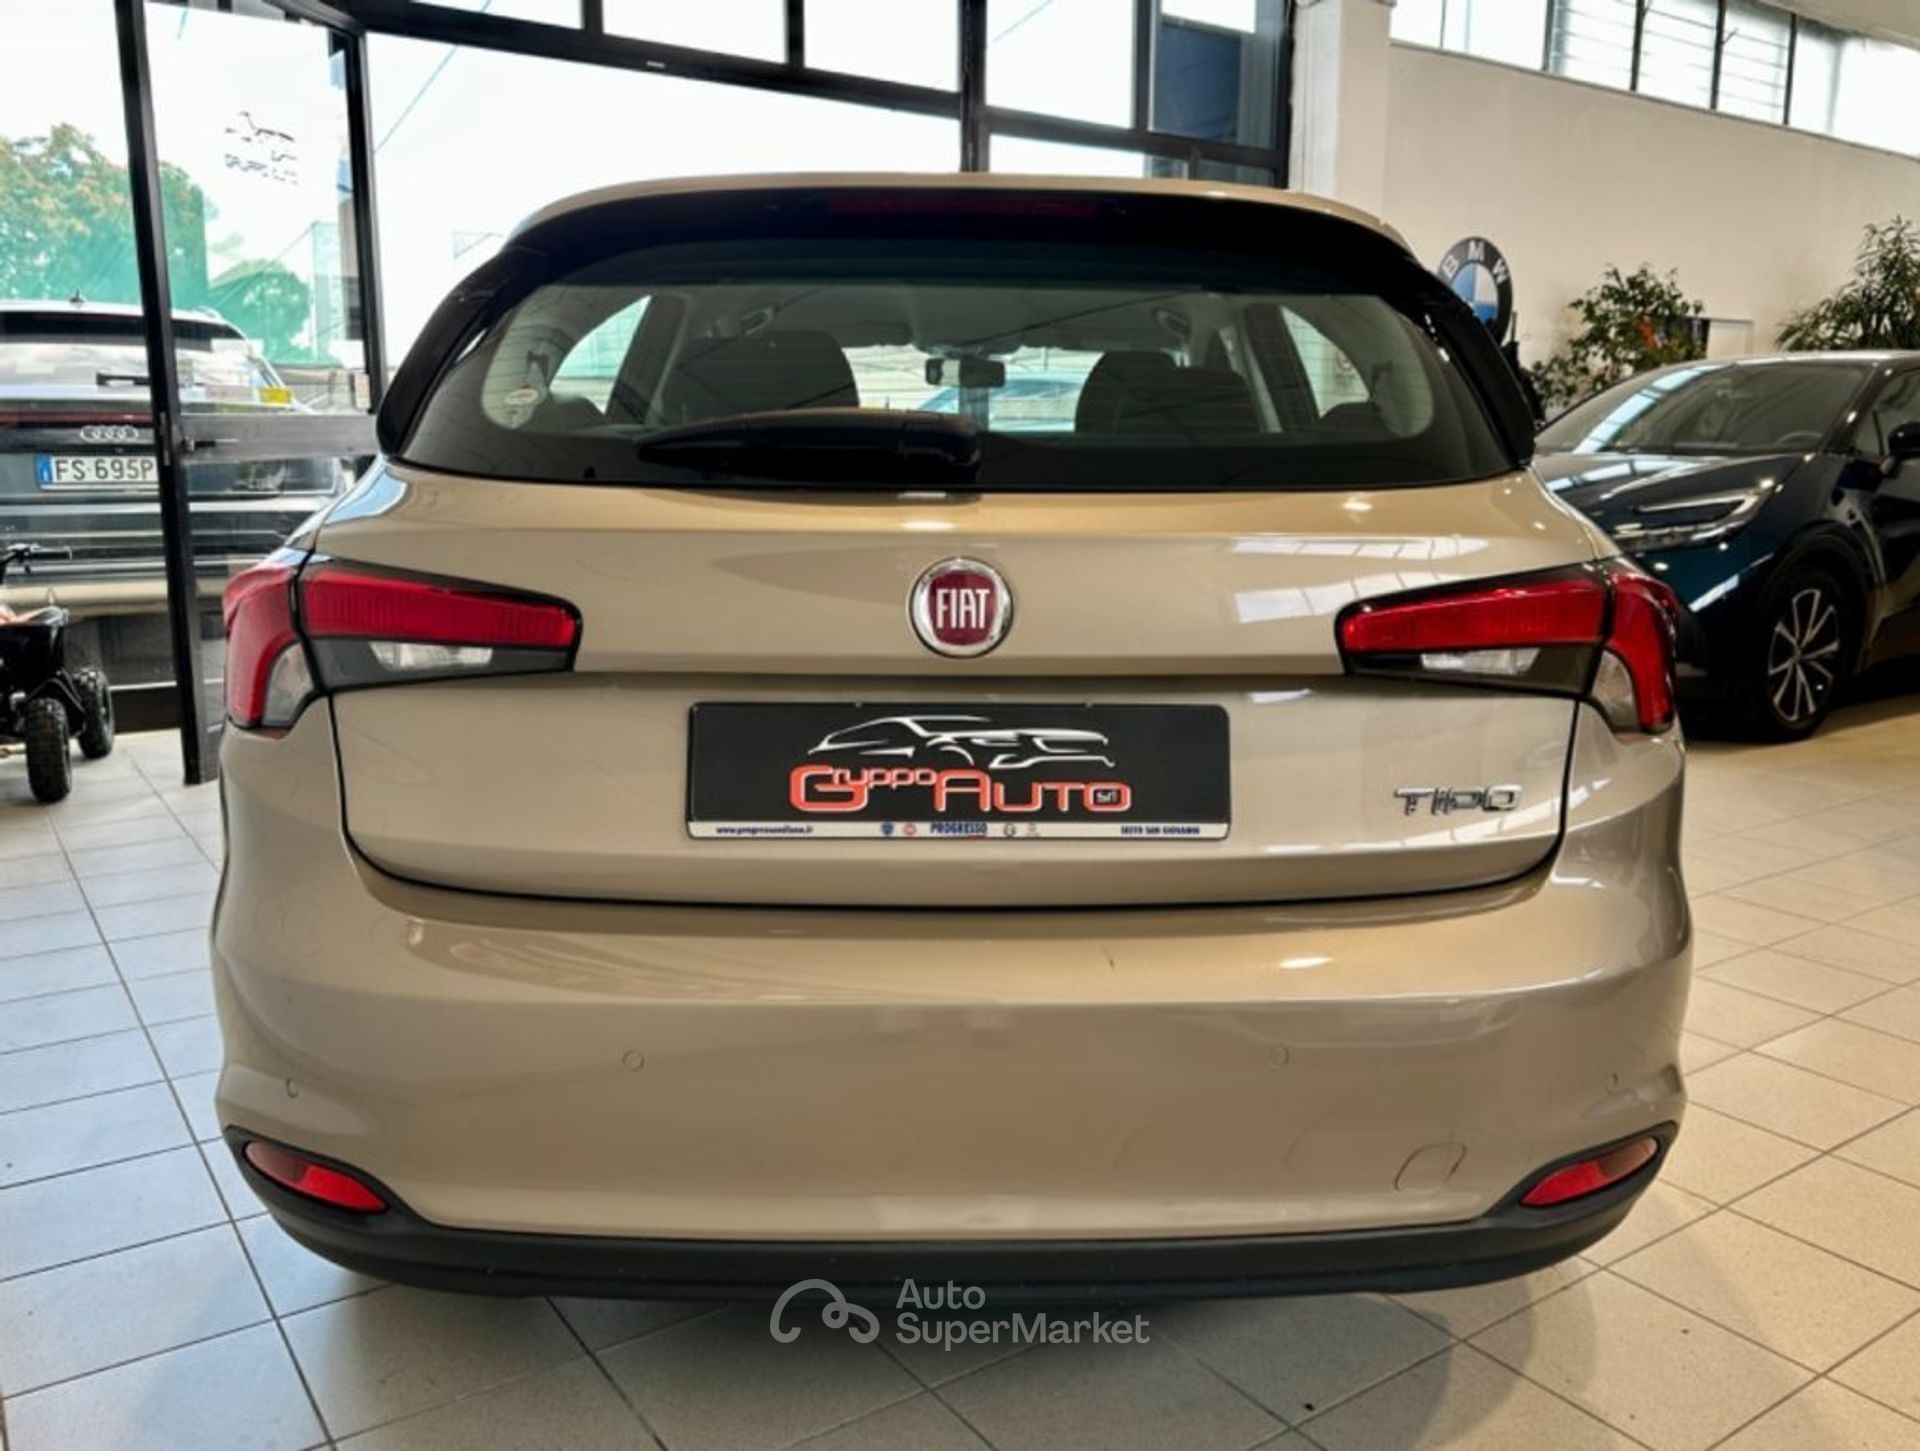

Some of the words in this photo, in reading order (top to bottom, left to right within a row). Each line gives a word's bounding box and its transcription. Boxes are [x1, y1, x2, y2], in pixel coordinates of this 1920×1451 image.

[1441, 239, 1509, 284] BMW
[54, 459, 87, 481] FS
[936, 587, 991, 630] FIAT
[1393, 784, 1523, 816] TIPO
[929, 821, 988, 834] PROGRESSO
